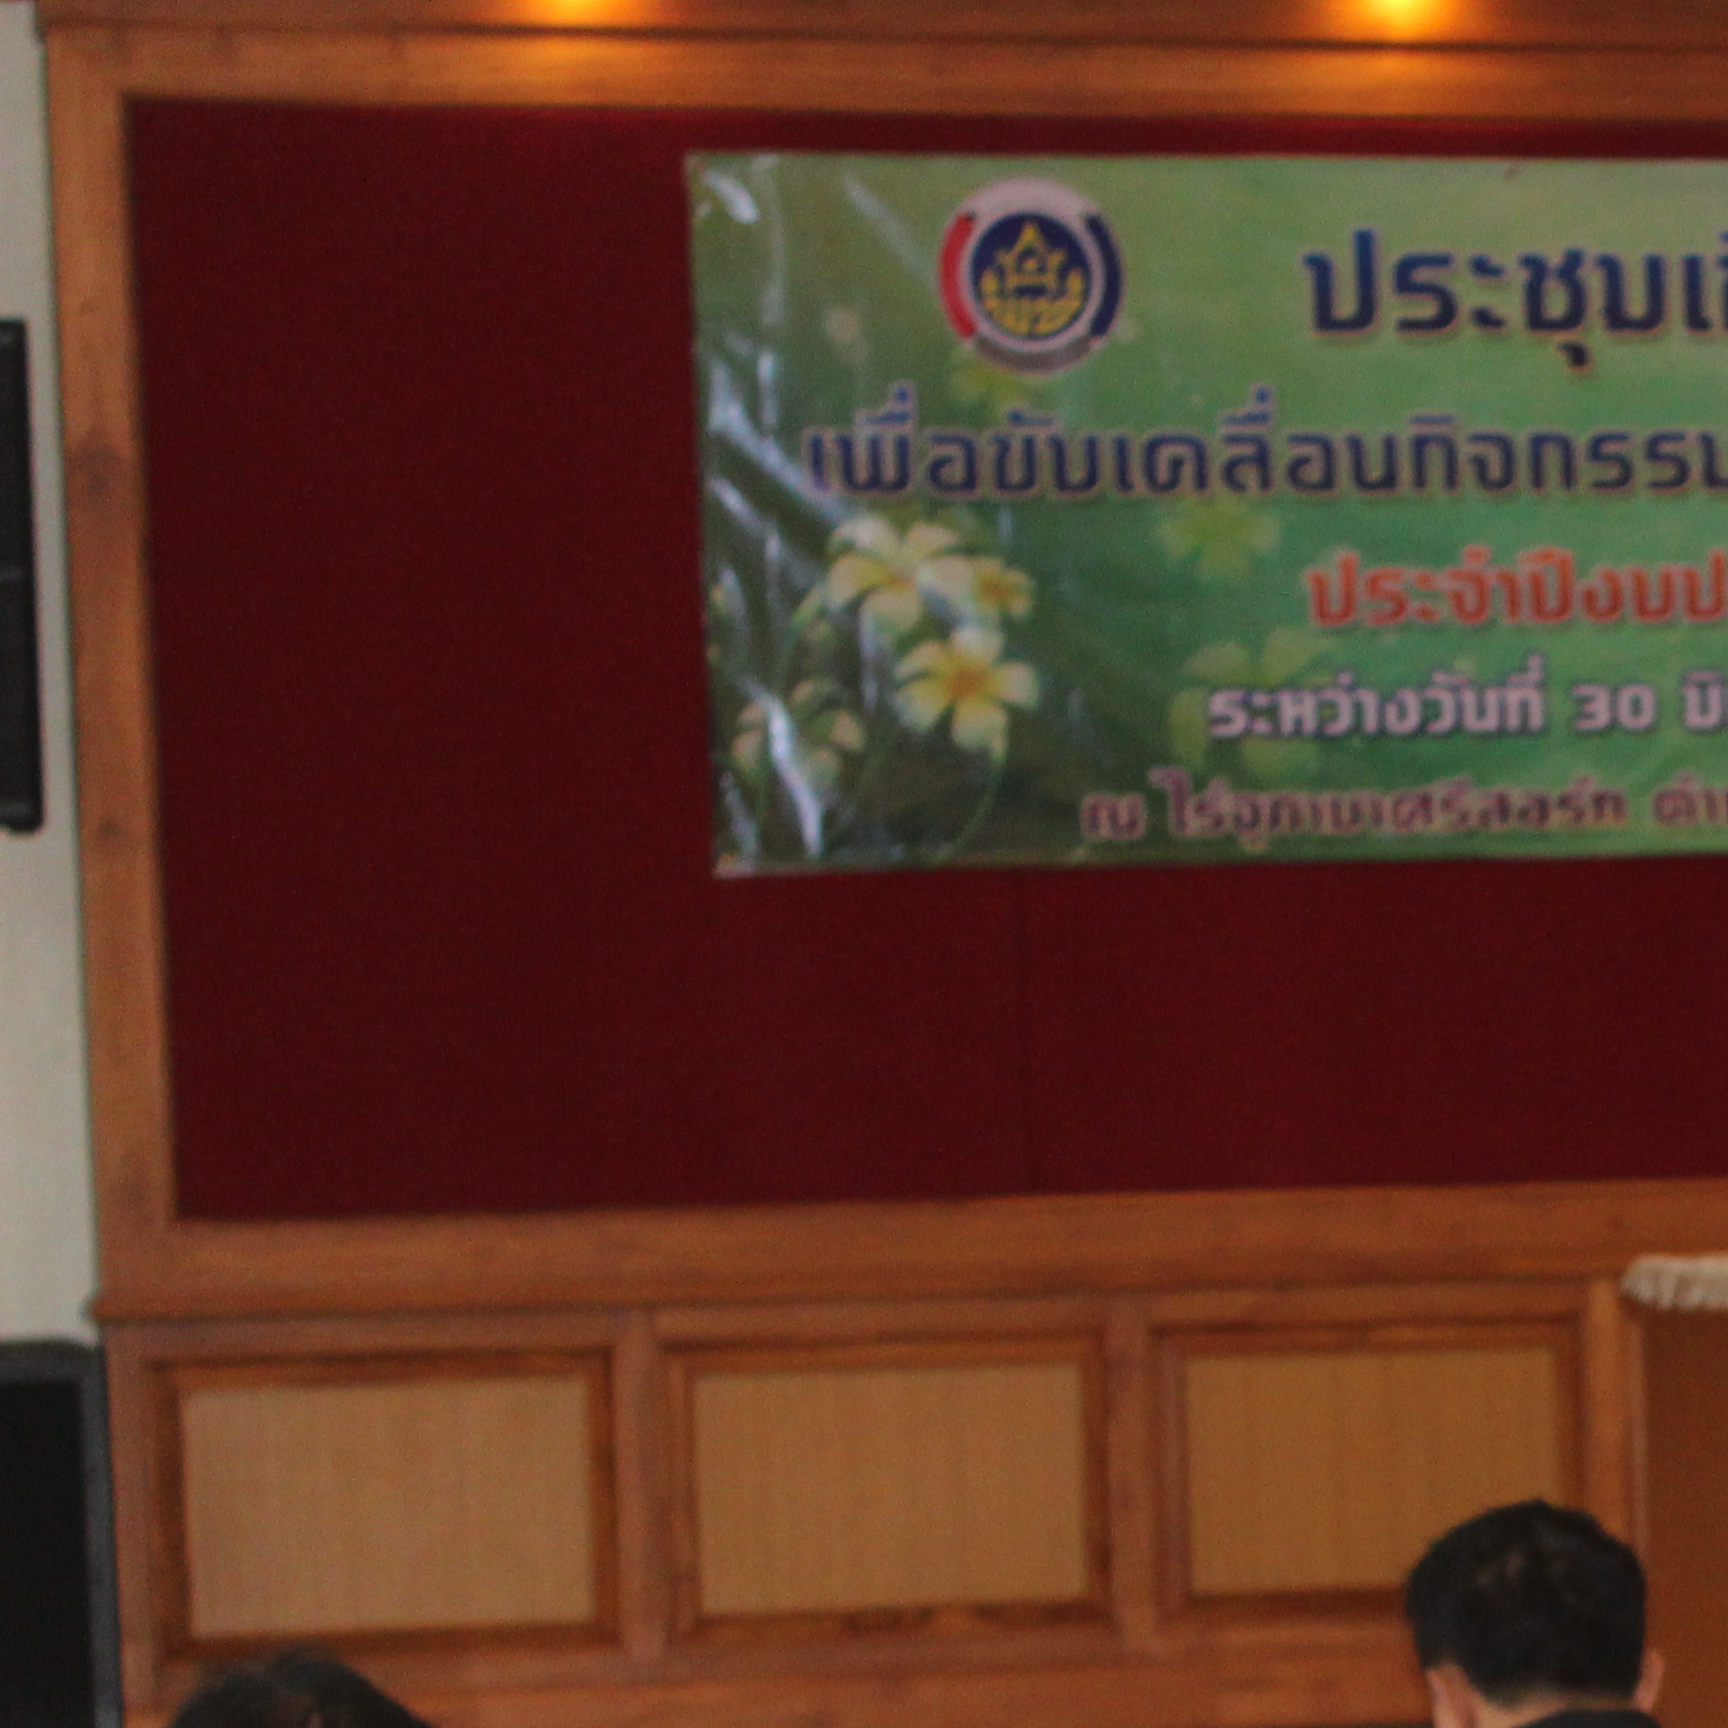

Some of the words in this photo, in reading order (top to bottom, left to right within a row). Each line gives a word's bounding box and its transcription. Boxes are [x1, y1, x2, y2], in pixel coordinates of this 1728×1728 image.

[1208, 654, 1544, 739] ระหว่างวันที่
[1572, 683, 1656, 733] 30
[1080, 792, 1147, 840] ณ
